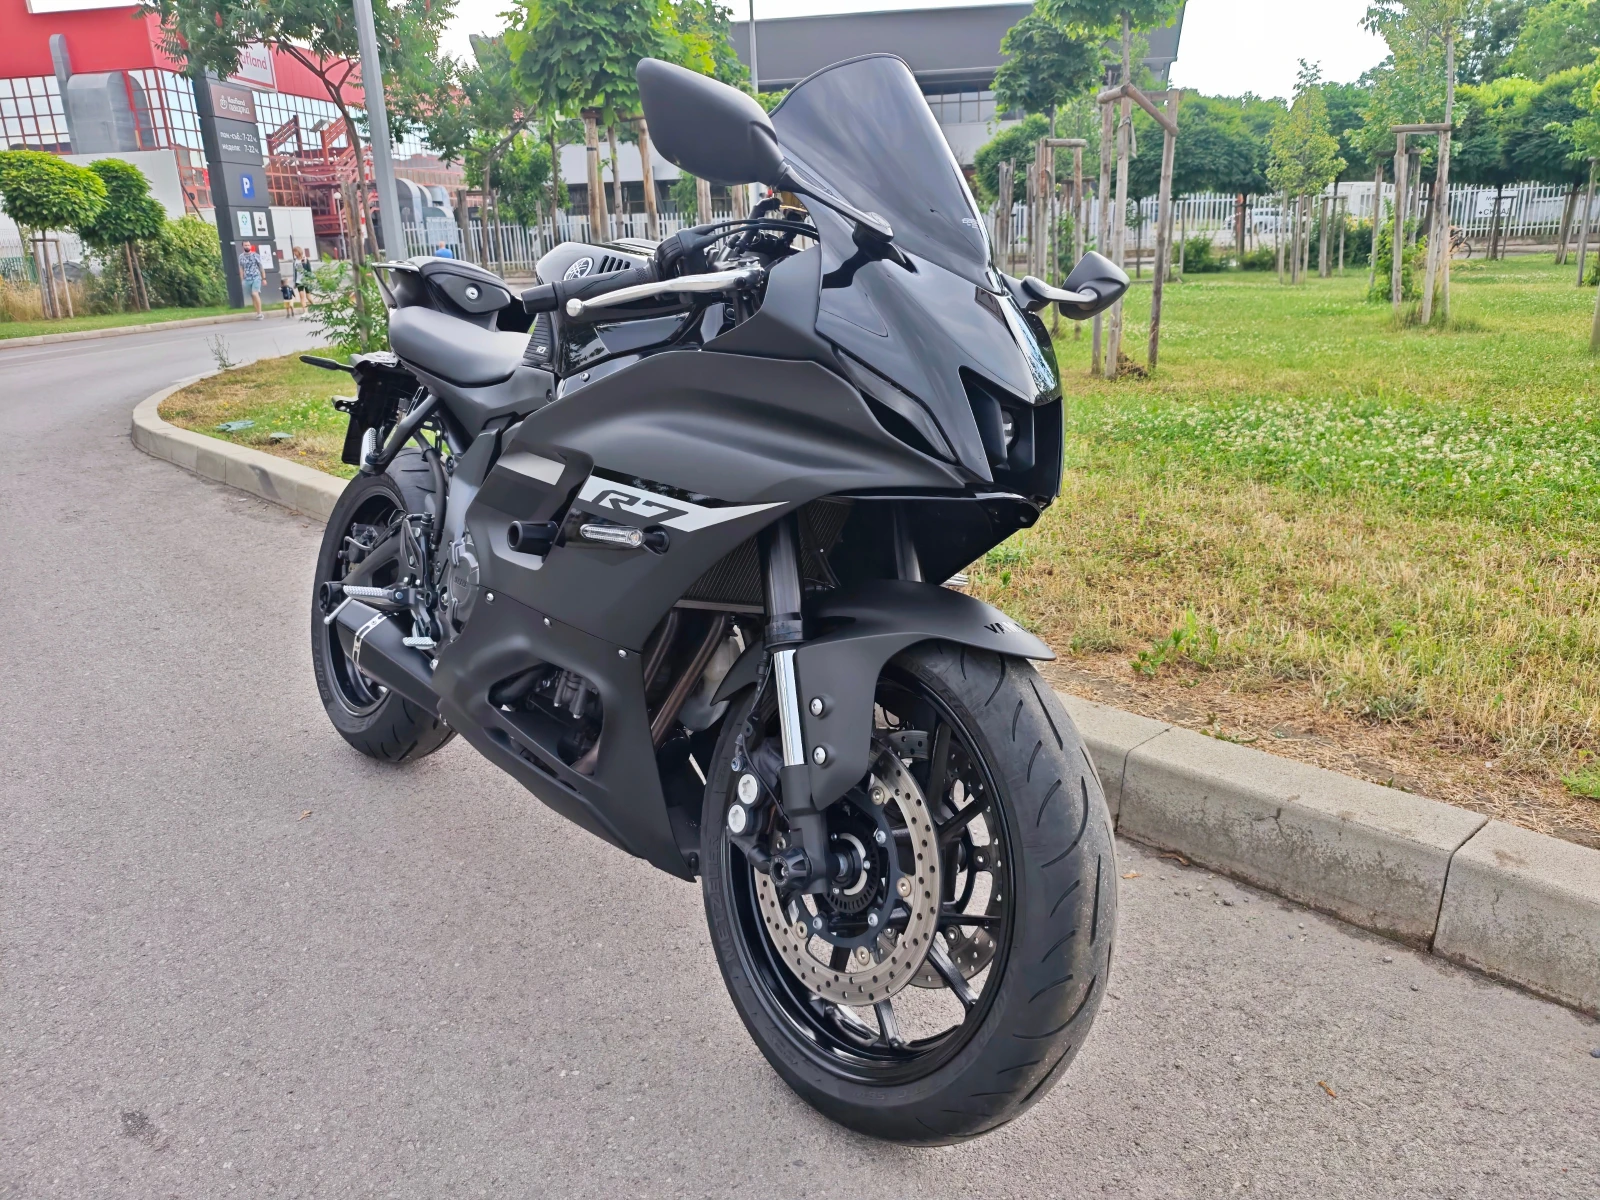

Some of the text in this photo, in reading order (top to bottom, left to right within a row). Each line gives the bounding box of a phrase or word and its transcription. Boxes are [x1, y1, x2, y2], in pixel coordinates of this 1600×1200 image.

[242, 177, 250, 194] P
[591, 489, 690, 524] R7
[707, 834, 737, 964] METZELER
